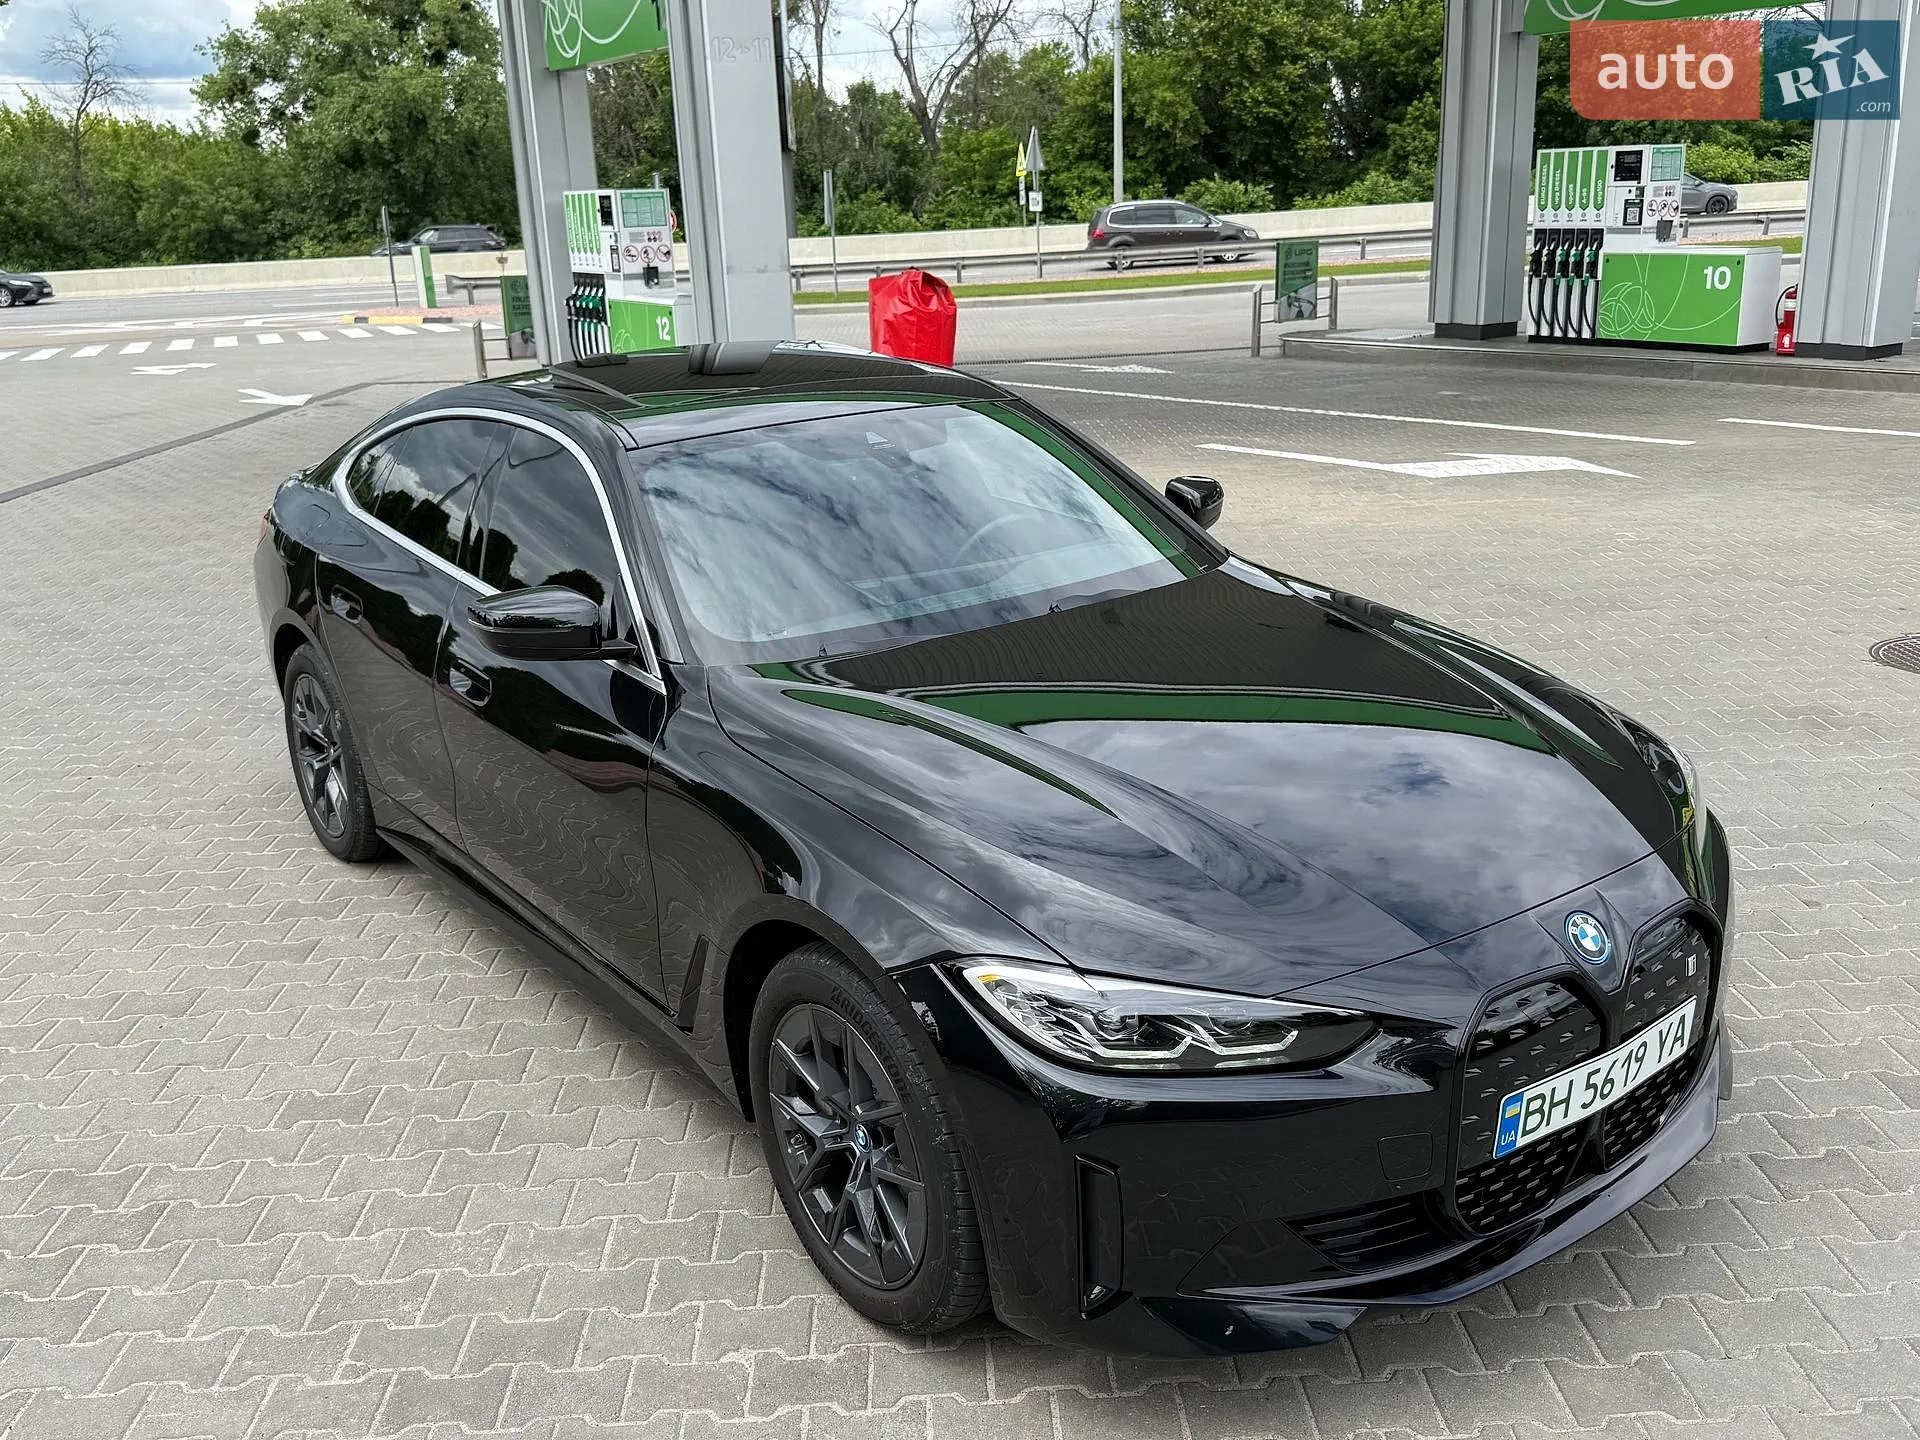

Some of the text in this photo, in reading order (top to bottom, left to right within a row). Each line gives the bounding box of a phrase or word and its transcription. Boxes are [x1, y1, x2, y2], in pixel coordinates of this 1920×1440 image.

[1703, 265, 1732, 290] 10
[656, 315, 671, 341] 12
[1521, 1013, 1687, 1139] BH 5619 YA
[1501, 1132, 1516, 1146] UA
